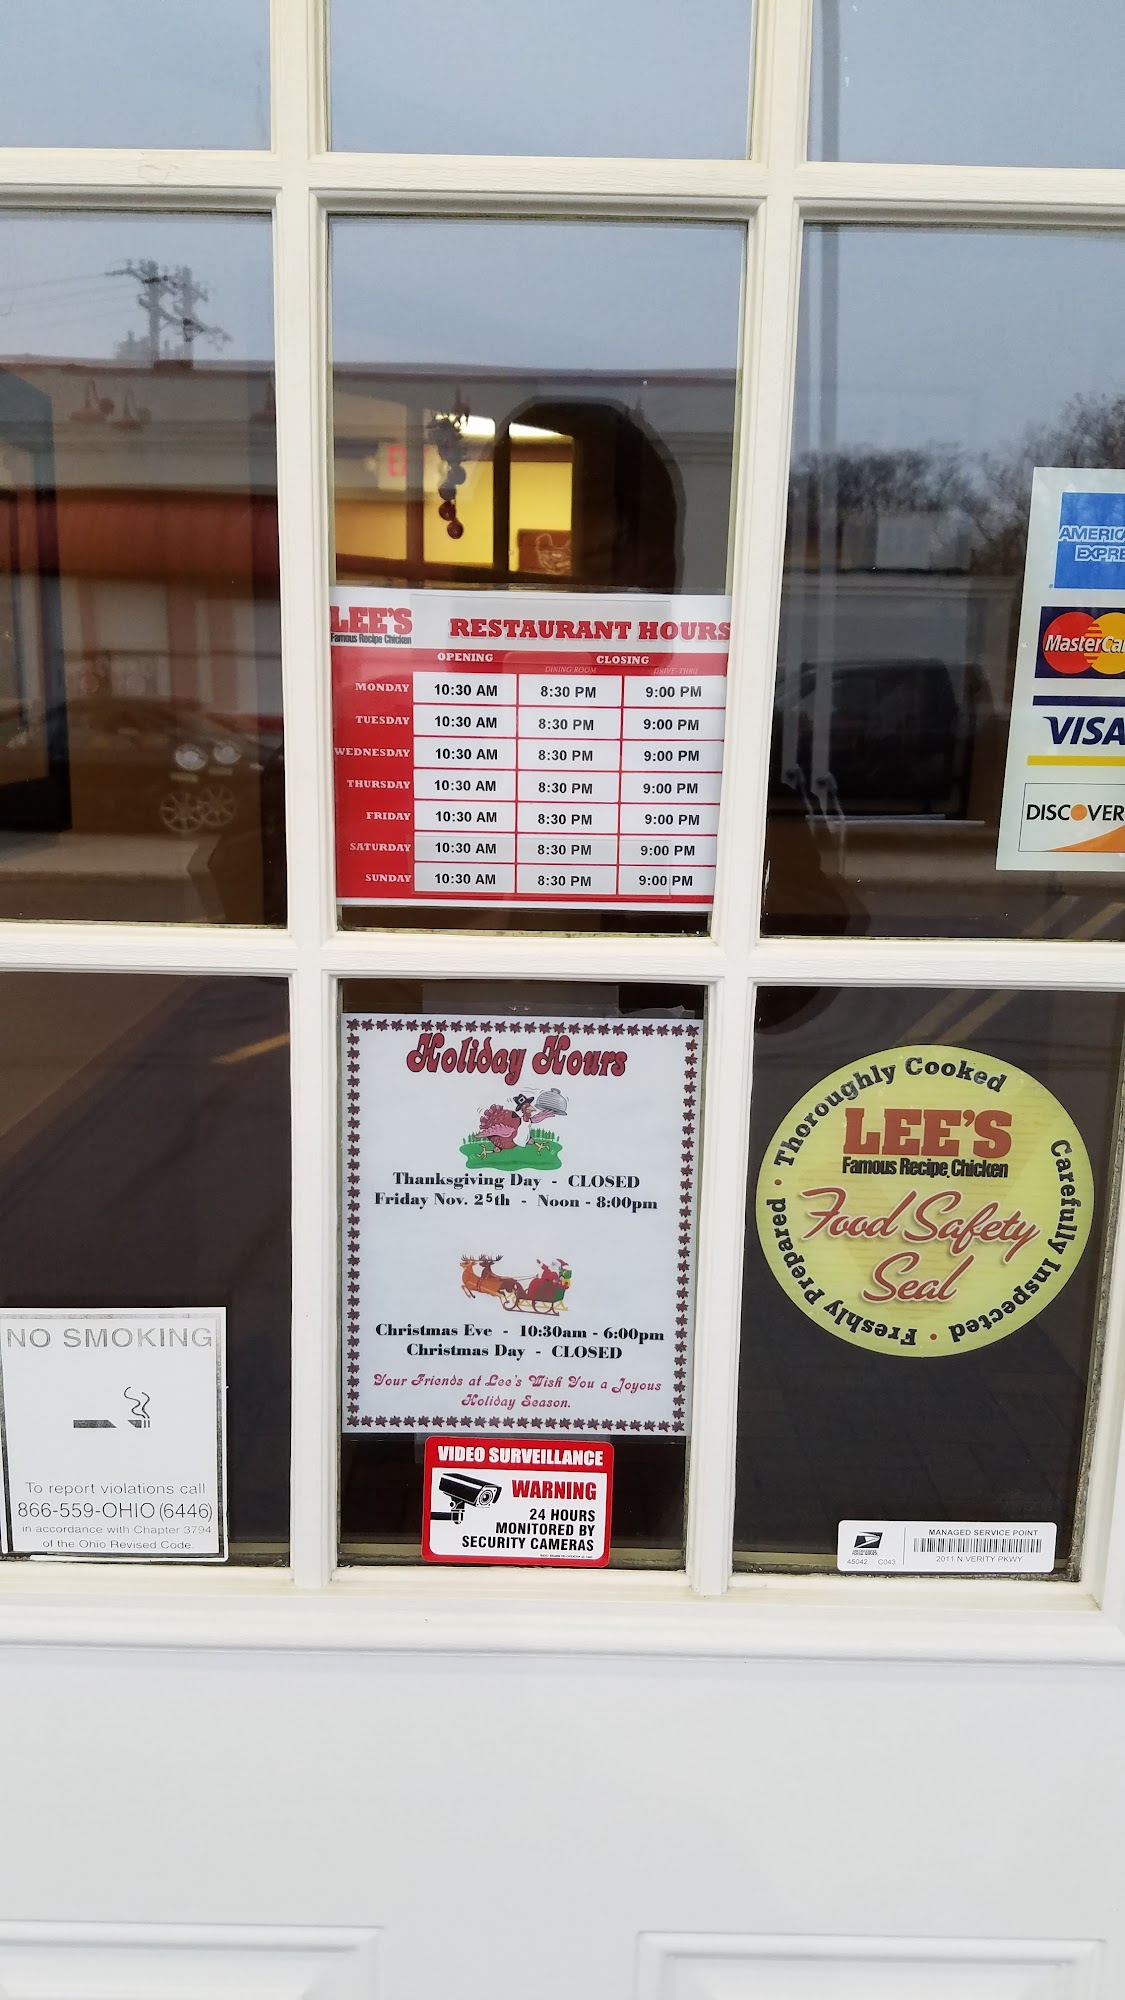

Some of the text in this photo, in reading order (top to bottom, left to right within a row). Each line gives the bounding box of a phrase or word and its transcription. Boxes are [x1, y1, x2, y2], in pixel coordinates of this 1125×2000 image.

[330, 606, 412, 634] LEE'S
[450, 618, 632, 640] RESTAURANT
[331, 633, 411, 644] Famous Recipe Chicken
[437, 653, 493, 661] OPENING
[596, 656, 649, 664] CLOSING
[355, 683, 409, 692] MONDAY
[434, 684, 497, 696] 10:30 AM
[541, 686, 596, 698] 8:30 PM
[646, 686, 702, 697] 9:00 PM
[355, 715, 410, 724] TUESDAY
[434, 716, 497, 728] 10:30 AM
[539, 719, 594, 730] 8:30 PM
[644, 719, 699, 730] 9:00 PM
[1043, 717, 1125, 745] VISA
[334, 748, 410, 757] WEDNESDAY
[436, 749, 497, 760] 10:30 AM
[538, 750, 593, 761] 8:30 PM
[644, 751, 699, 761] 9:00 PM
[347, 779, 410, 789] THURSDAY
[434, 780, 496, 791] 10:30 AM
[538, 782, 593, 794] 8:30 PM
[643, 783, 698, 794] 9:00 PM
[366, 812, 411, 820] FRIDAY
[436, 811, 497, 822] 10:30 AM
[1026, 804, 1124, 821] DISCOVER
[538, 814, 592, 825] 8:30 PM
[645, 815, 699, 825] 9:00 PM
[350, 843, 411, 852] SATURDAY
[435, 843, 496, 854] 10:30 AM
[538, 845, 591, 855] 8:30 PM
[641, 845, 695, 855] 9:00 PM
[365, 874, 411, 882] SUNDAY
[434, 874, 495, 884] 10:30 AM
[538, 876, 591, 886] 8:30 PM
[639, 876, 693, 886] 9:00 PM
[406, 1033, 627, 1085] Holiday Hours
[774, 1056, 1008, 1168] Thoroughly Cooked
[843, 1107, 1013, 1159] LEE'S
[842, 1157, 897, 1174] Famous
[951, 1159, 1008, 1177] Chicken
[393, 1172, 505, 1190] Thanksgiving
[510, 1174, 541, 1191] Day
[568, 1175, 640, 1188] CLOSED
[375, 1193, 428, 1209] Friday
[434, 1193, 467, 1206] Nov.
[474, 1193, 510, 1206] 25th
[538, 1195, 579, 1207] Noon
[596, 1197, 657, 1213] 8:00pm
[801, 1186, 1041, 1263] Food Safety
[948, 1139, 1082, 1343] Carefully Inspected
[766, 1198, 917, 1346] Freshly Prepared
[861, 1251, 974, 1302] Seal
[7, 1327, 212, 1348] NO SMOKING
[375, 1324, 458, 1337] Christmas
[463, 1324, 493, 1337] Eve
[520, 1325, 587, 1338] 10:30am
[603, 1326, 665, 1344] 6:00pm
[406, 1344, 489, 1357] Christmas
[495, 1345, 526, 1361] Day
[551, 1345, 623, 1359] CLOSED
[374, 1374, 661, 1393] Your Friends at Lee's Wish You a Joyous
[461, 1394, 571, 1410] Holiday Season.
[438, 1445, 603, 1466] VIDEO SURVEILLANCE
[25, 1481, 206, 1496] To report violations call
[512, 1480, 597, 1500] WARNING
[530, 1508, 595, 1522] 24 HOURS
[22, 1525, 211, 1535] in accordance with Chapter 3794
[496, 1522, 595, 1537] MONITORED BY
[43, 1540, 54, 1548] of
[57, 1540, 75, 1548] the
[79, 1540, 106, 1548] Ohio
[111, 1540, 157, 1549] Revised
[462, 1536, 594, 1551] SECURITY CAMERAS
